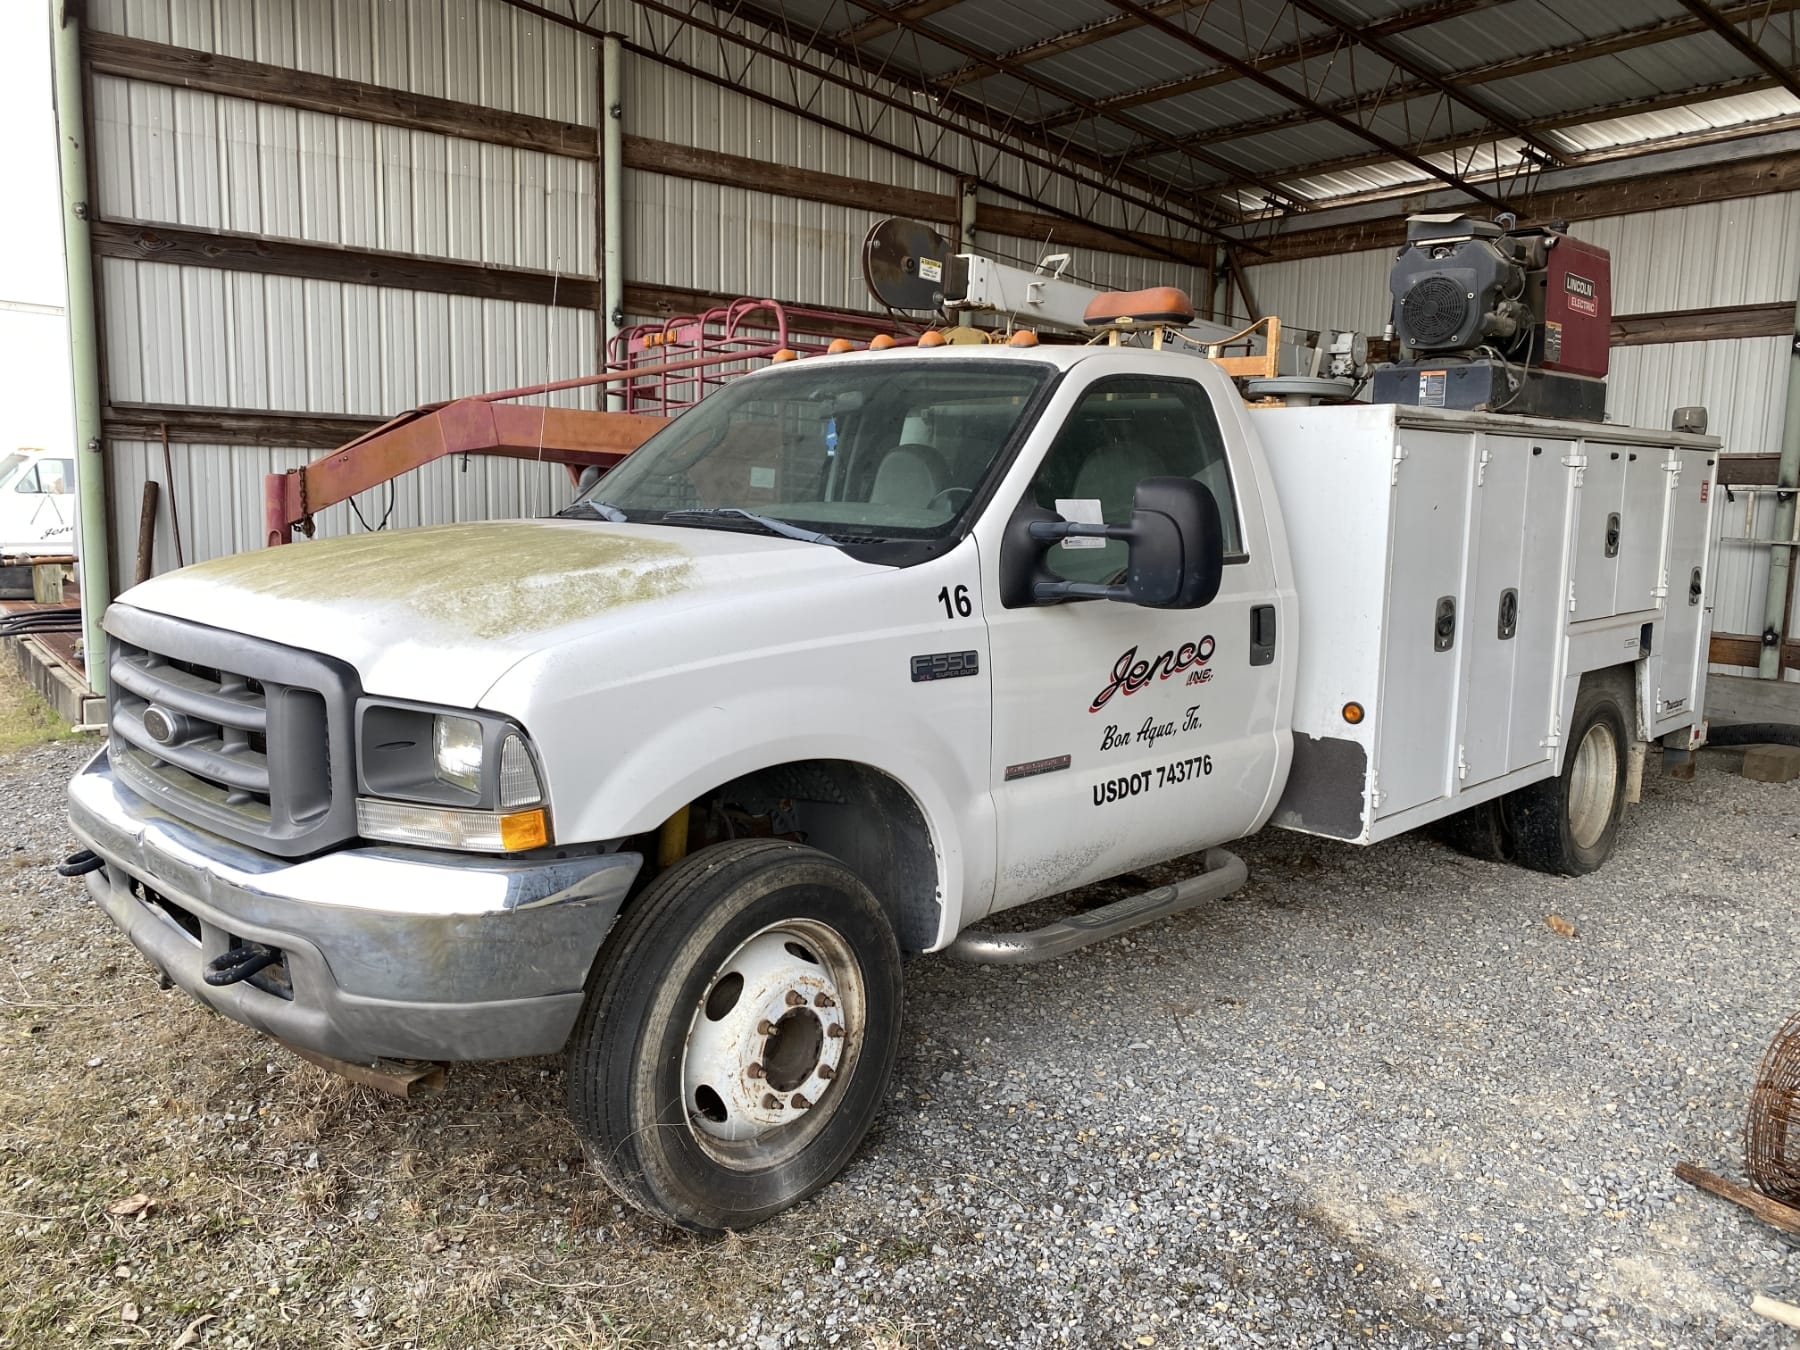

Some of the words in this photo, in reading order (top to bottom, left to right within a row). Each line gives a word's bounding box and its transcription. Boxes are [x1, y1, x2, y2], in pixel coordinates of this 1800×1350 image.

[1566, 276, 1592, 296] LINCOLN
[1571, 296, 1595, 313] ELECTRIC
[938, 584, 972, 619] 16
[912, 652, 978, 674] F-550
[935, 670, 959, 679] SUPER
[1089, 635, 1215, 713] Jenco
[1100, 724, 1131, 751] Bon
[1136, 716, 1177, 748] Aqua,
[1093, 769, 1152, 806] USDOT
[1156, 754, 1213, 789] 743776
